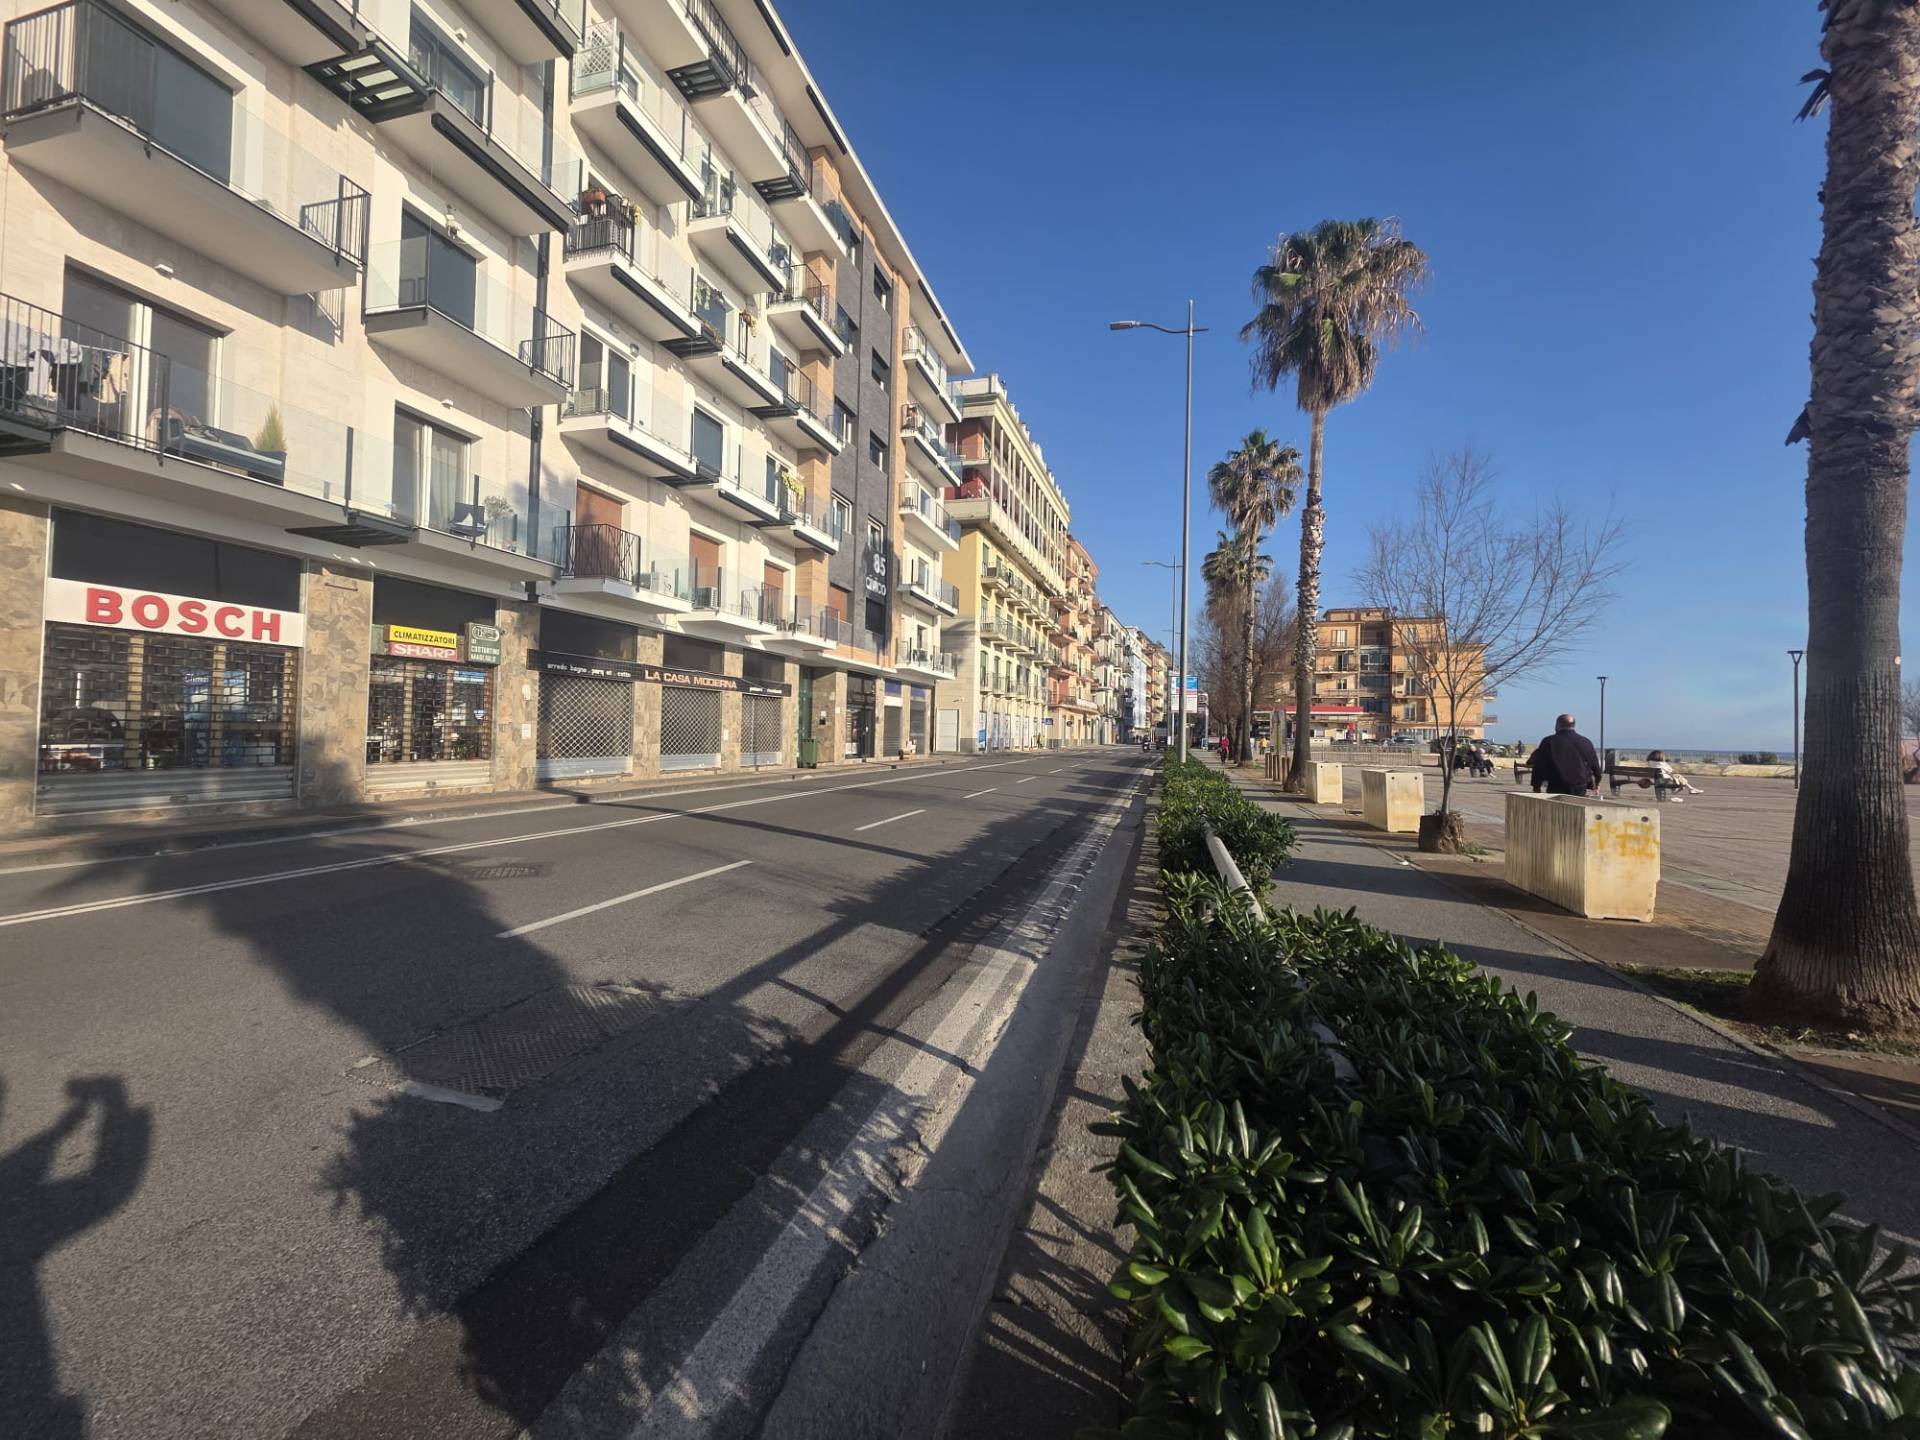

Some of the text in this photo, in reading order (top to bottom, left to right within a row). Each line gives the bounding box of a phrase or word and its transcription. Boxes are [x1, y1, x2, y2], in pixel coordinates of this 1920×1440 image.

[873, 553, 886, 576] 85
[86, 587, 281, 642] BOSCH
[394, 630, 455, 645] CLIMATIZZATORI
[394, 643, 456, 659] SHARP
[644, 669, 661, 681] LA
[663, 672, 691, 685] CASA
[693, 676, 738, 689] MODERNA
